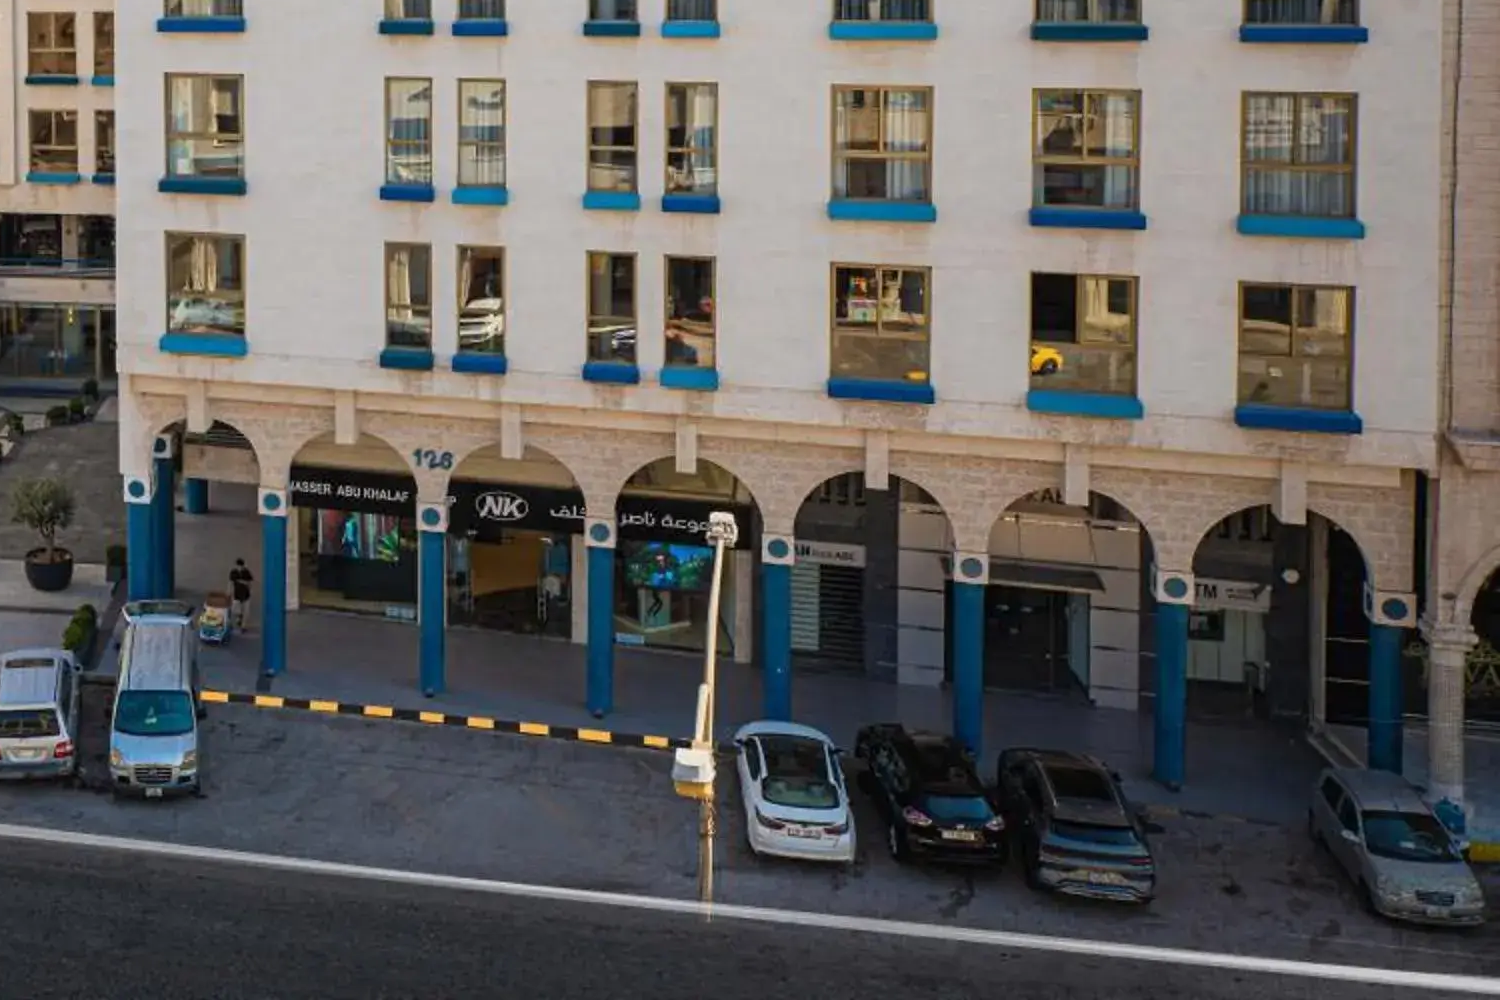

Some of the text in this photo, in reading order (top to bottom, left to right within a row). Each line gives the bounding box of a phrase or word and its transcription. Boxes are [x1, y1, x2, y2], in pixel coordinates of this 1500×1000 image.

[336, 484, 361, 498] ABU
[363, 487, 409, 503] KHALAF
[477, 495, 527, 519] NK
